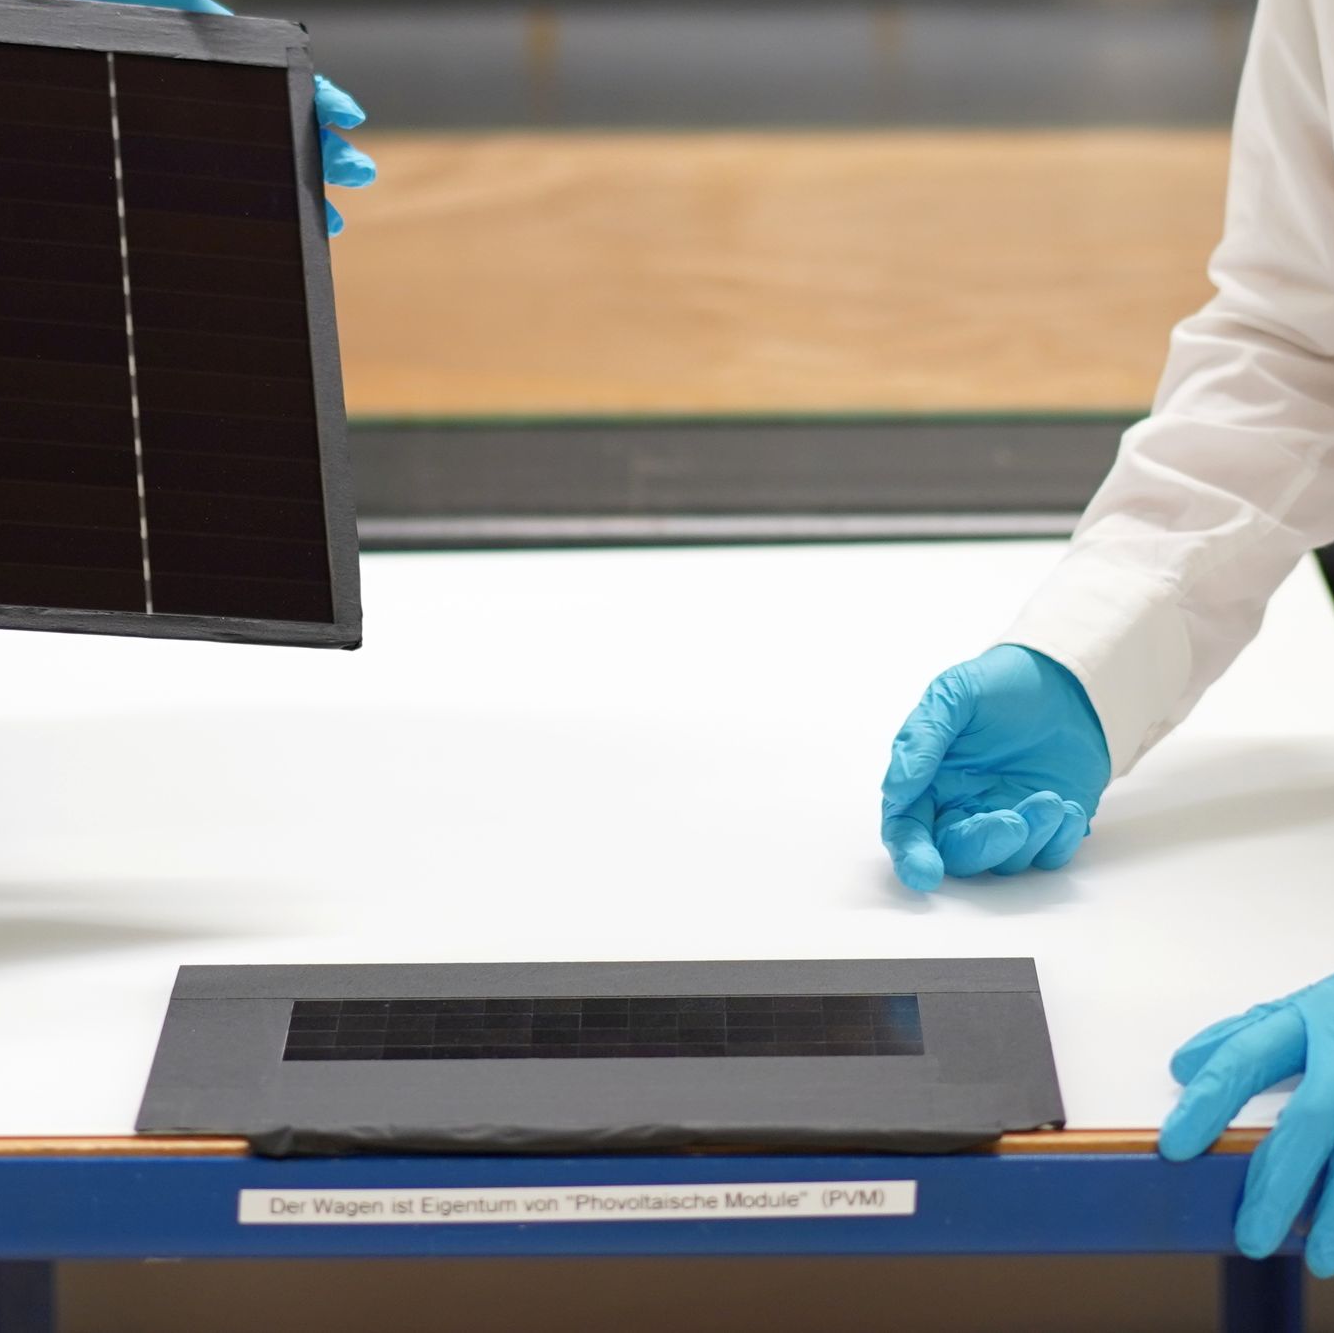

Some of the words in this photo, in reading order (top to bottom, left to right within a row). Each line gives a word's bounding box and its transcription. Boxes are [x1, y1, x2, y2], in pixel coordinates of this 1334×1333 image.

[270, 1198, 305, 1214] Der
[313, 1198, 383, 1217] Wagen
[392, 1198, 414, 1213] ist
[421, 1197, 517, 1217] Eigentum
[524, 1199, 558, 1212] von
[822, 1189, 886, 1209] (PVM)
